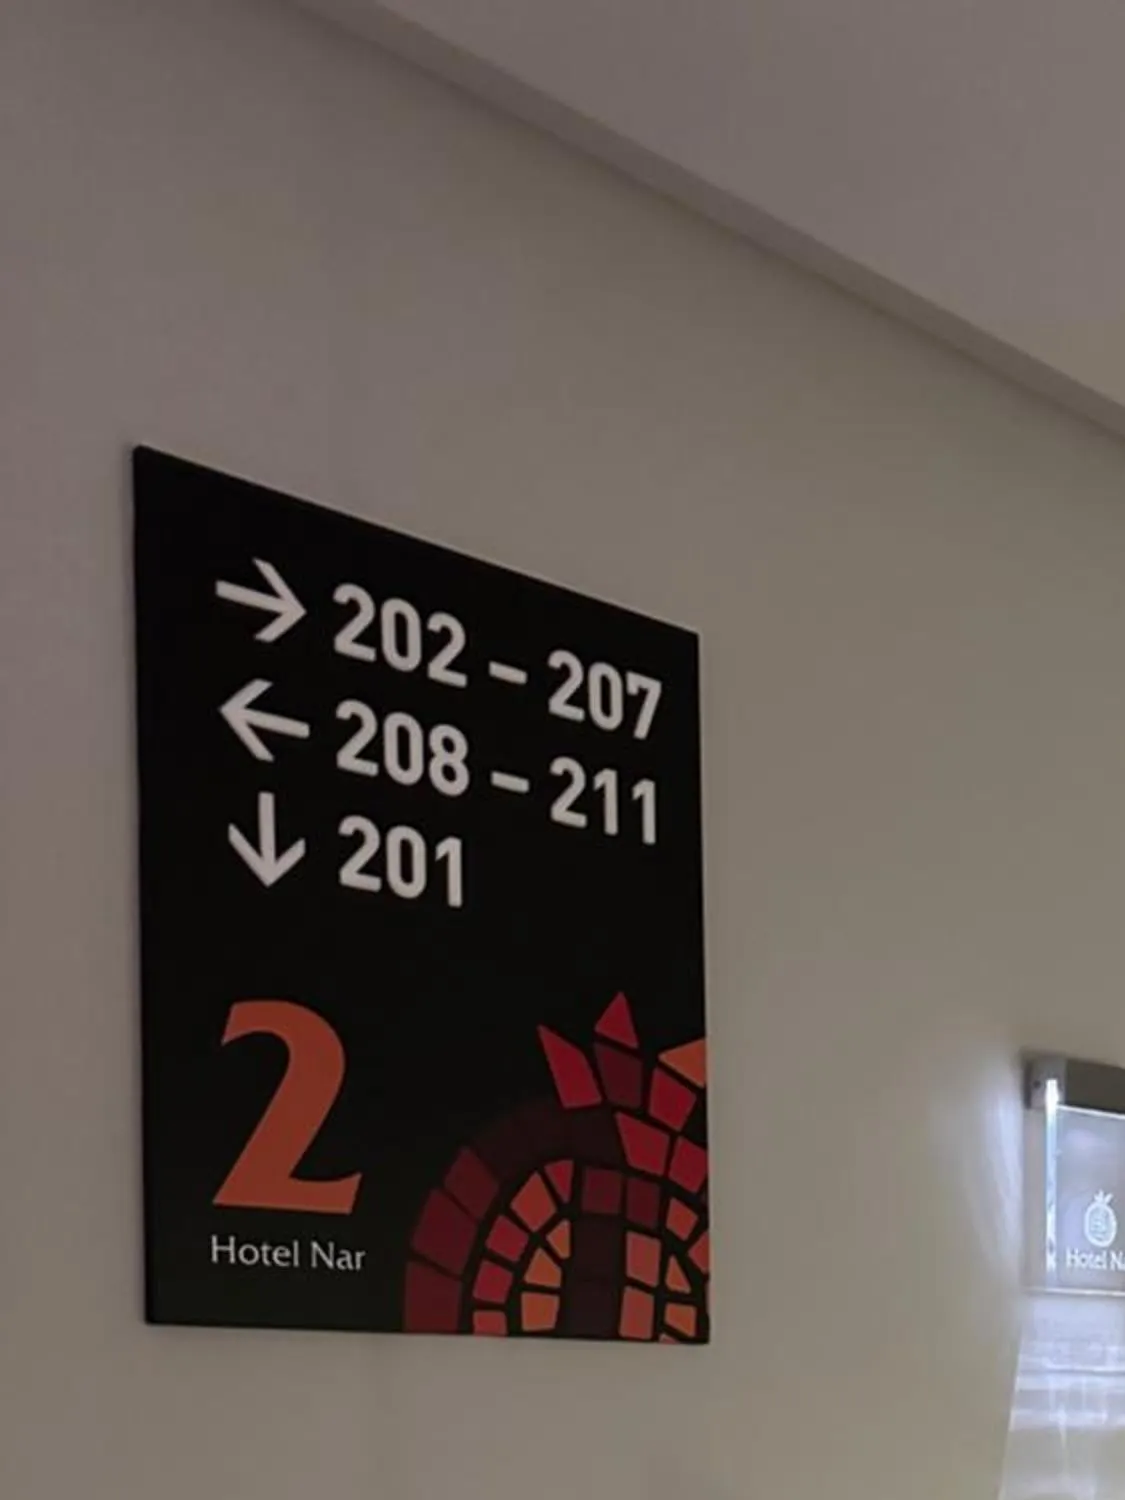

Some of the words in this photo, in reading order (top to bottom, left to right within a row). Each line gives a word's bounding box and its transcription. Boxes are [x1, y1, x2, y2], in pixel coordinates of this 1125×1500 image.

[333, 582, 468, 688] 202
[547, 649, 662, 740] 207
[336, 698, 470, 797] 208
[549, 756, 657, 846] 211
[338, 814, 464, 909] 201
[211, 1000, 363, 1215] 2
[210, 1234, 300, 1268] Hotel
[310, 1241, 367, 1272] Nar
[1065, 1246, 1107, 1270] Hotel
